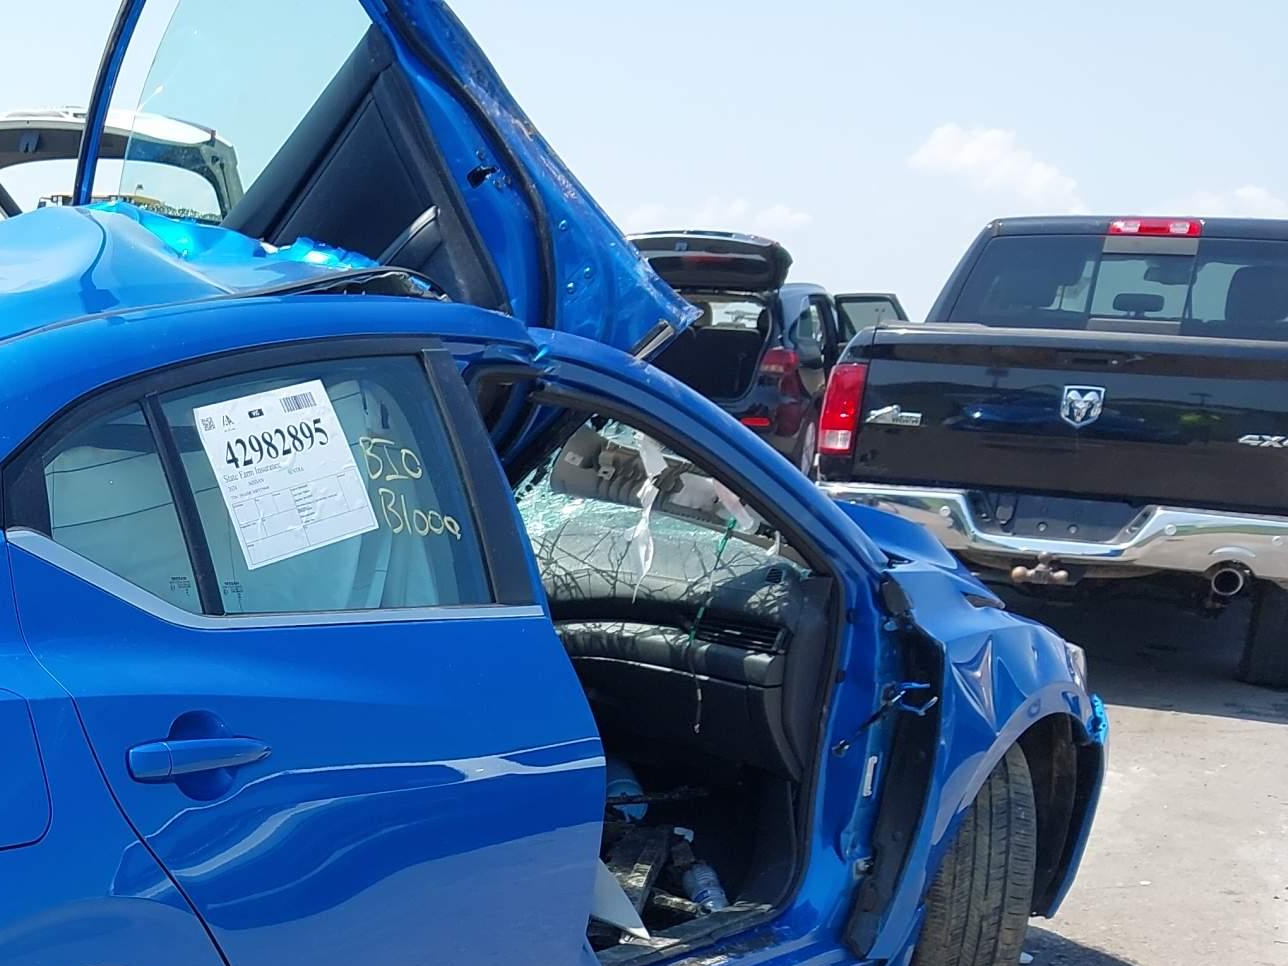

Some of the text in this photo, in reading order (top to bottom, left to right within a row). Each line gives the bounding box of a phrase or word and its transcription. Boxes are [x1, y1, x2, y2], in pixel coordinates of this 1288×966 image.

[225, 417, 329, 469] 42982895
[359, 436, 423, 481] BIO
[223, 473, 239, 483] State
[239, 469, 255, 480] Farm
